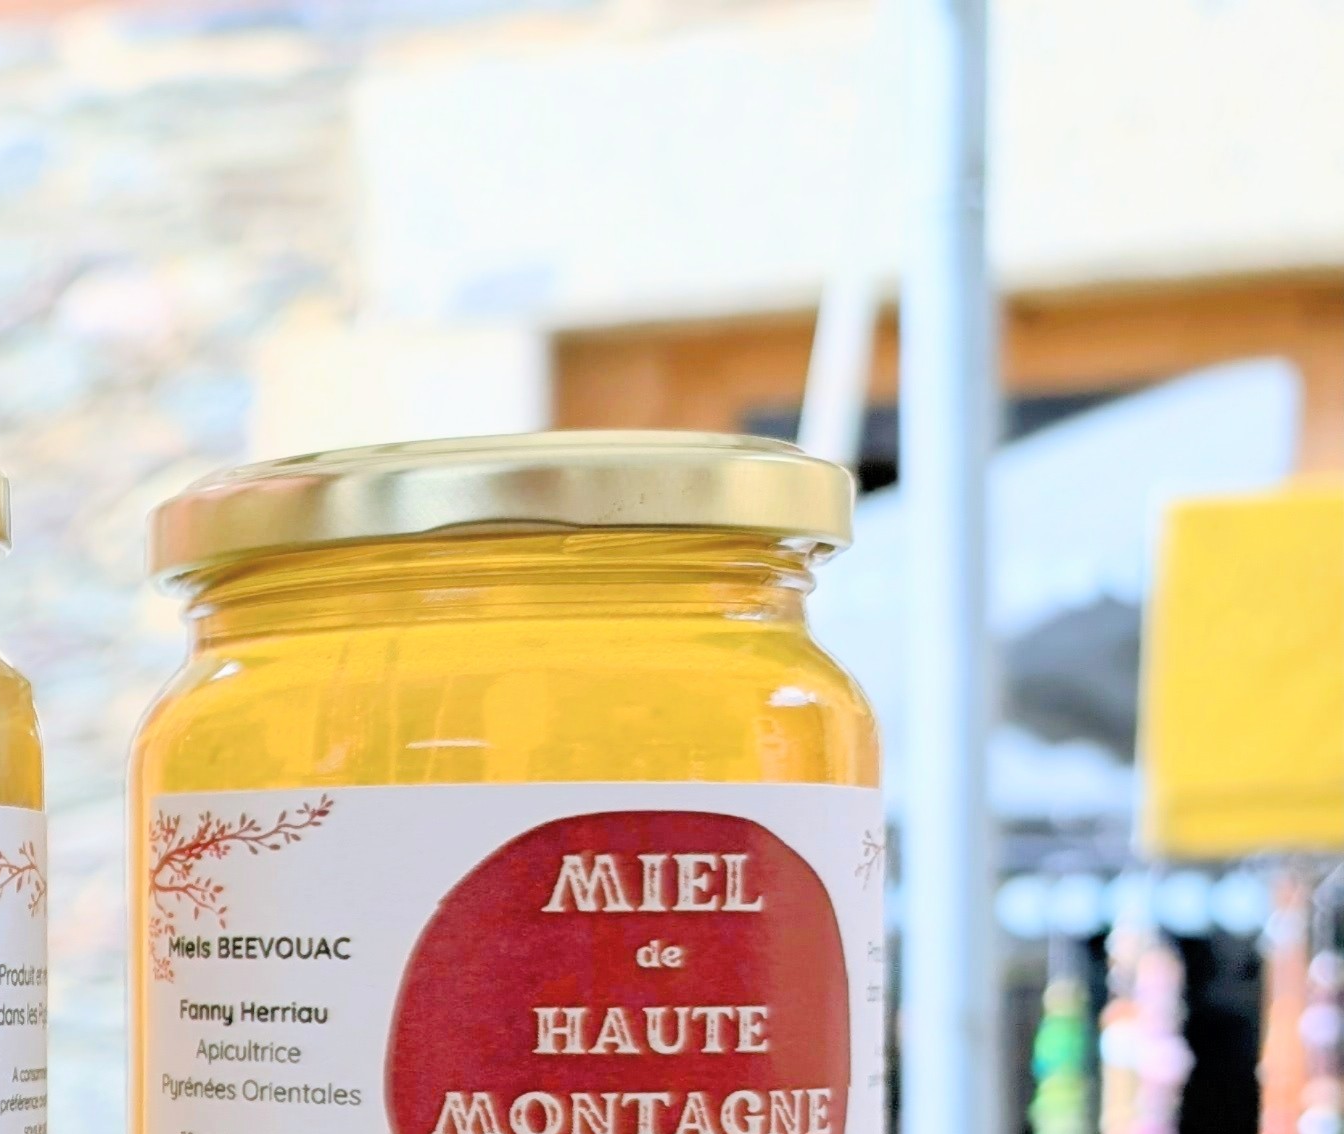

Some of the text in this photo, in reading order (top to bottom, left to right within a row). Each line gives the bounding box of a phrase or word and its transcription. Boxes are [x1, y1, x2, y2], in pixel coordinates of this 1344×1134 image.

[540, 853, 764, 913] MIEL
[168, 936, 351, 960] Miels BEEVOUAC
[636, 939, 684, 968] de
[179, 999, 328, 1026] Fanny Herriau
[532, 1006, 769, 1056] HAUTE
[196, 1039, 301, 1064] Apicultrice
[162, 1073, 362, 1107] Pyrénées Orientales
